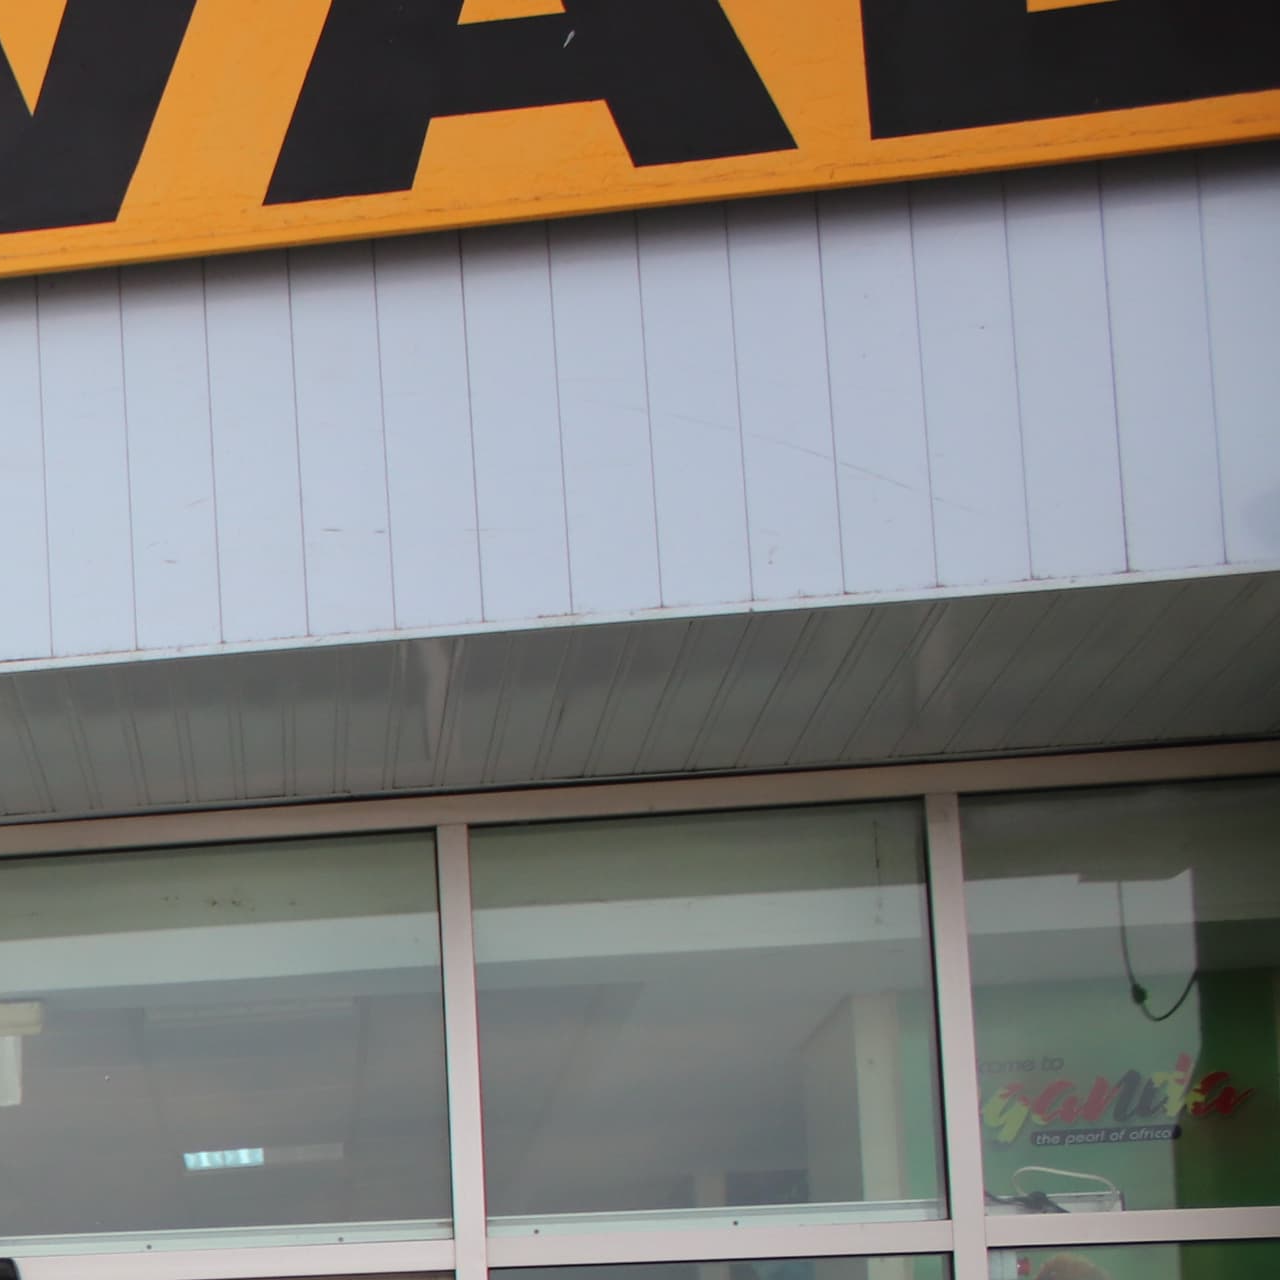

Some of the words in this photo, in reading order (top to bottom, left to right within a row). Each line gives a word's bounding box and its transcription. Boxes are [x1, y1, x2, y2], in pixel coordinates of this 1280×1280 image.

[1036, 1133, 1061, 1145] the
[1064, 1131, 1105, 1147] pearl
[1109, 1128, 1127, 1142] of
[1129, 1126, 1173, 1141] africa
